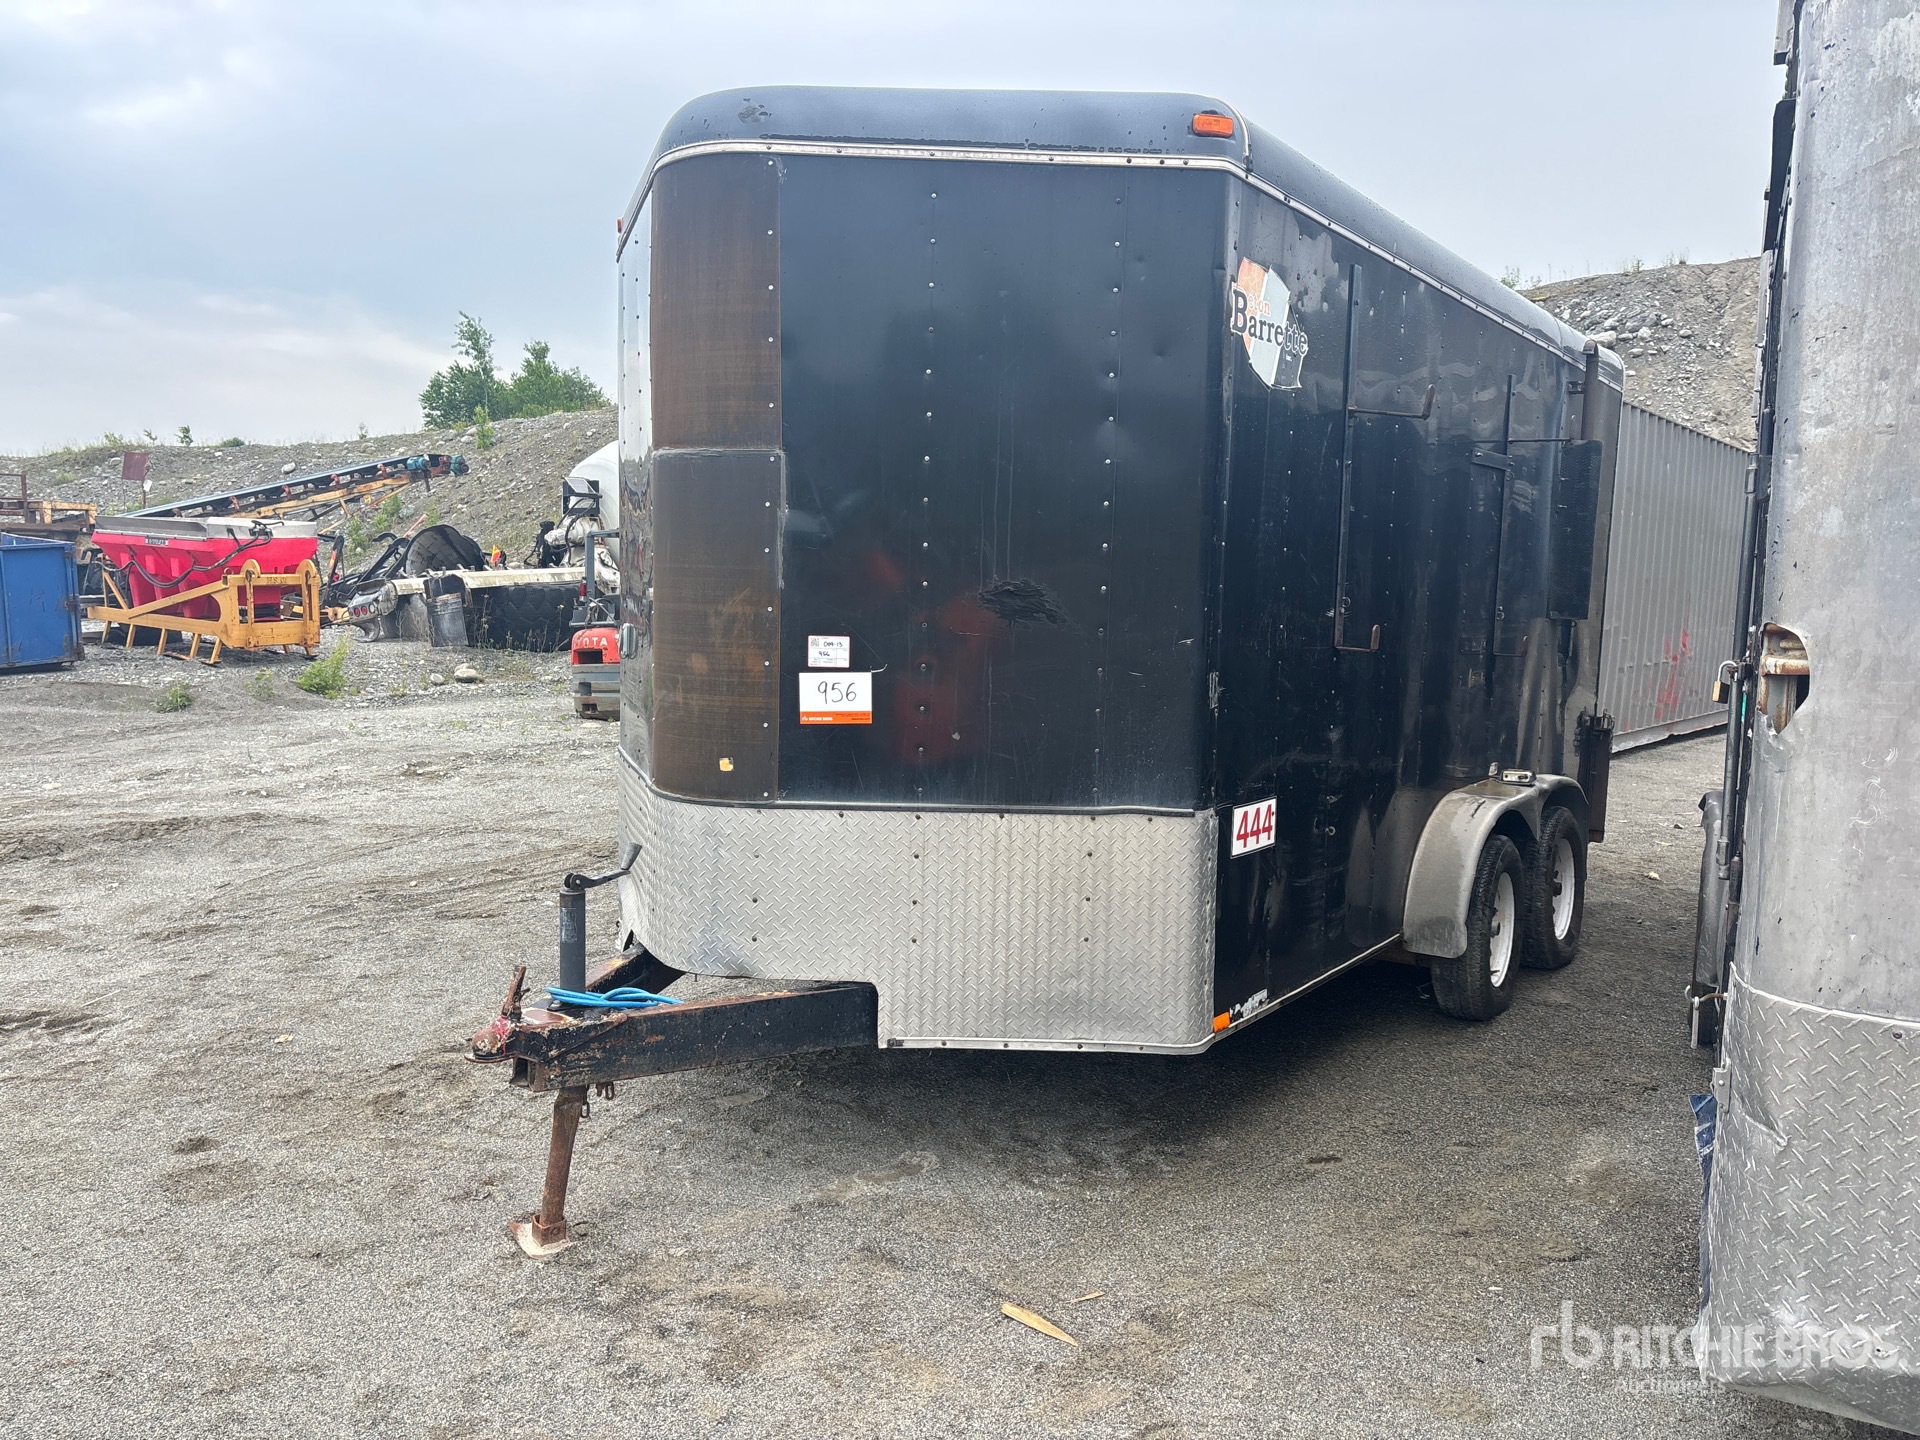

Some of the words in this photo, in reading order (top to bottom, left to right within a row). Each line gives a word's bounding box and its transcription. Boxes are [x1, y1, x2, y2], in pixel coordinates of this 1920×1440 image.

[1232, 284, 1309, 356] Barrette
[817, 680, 857, 705] 956
[1236, 804, 1273, 848] 444
